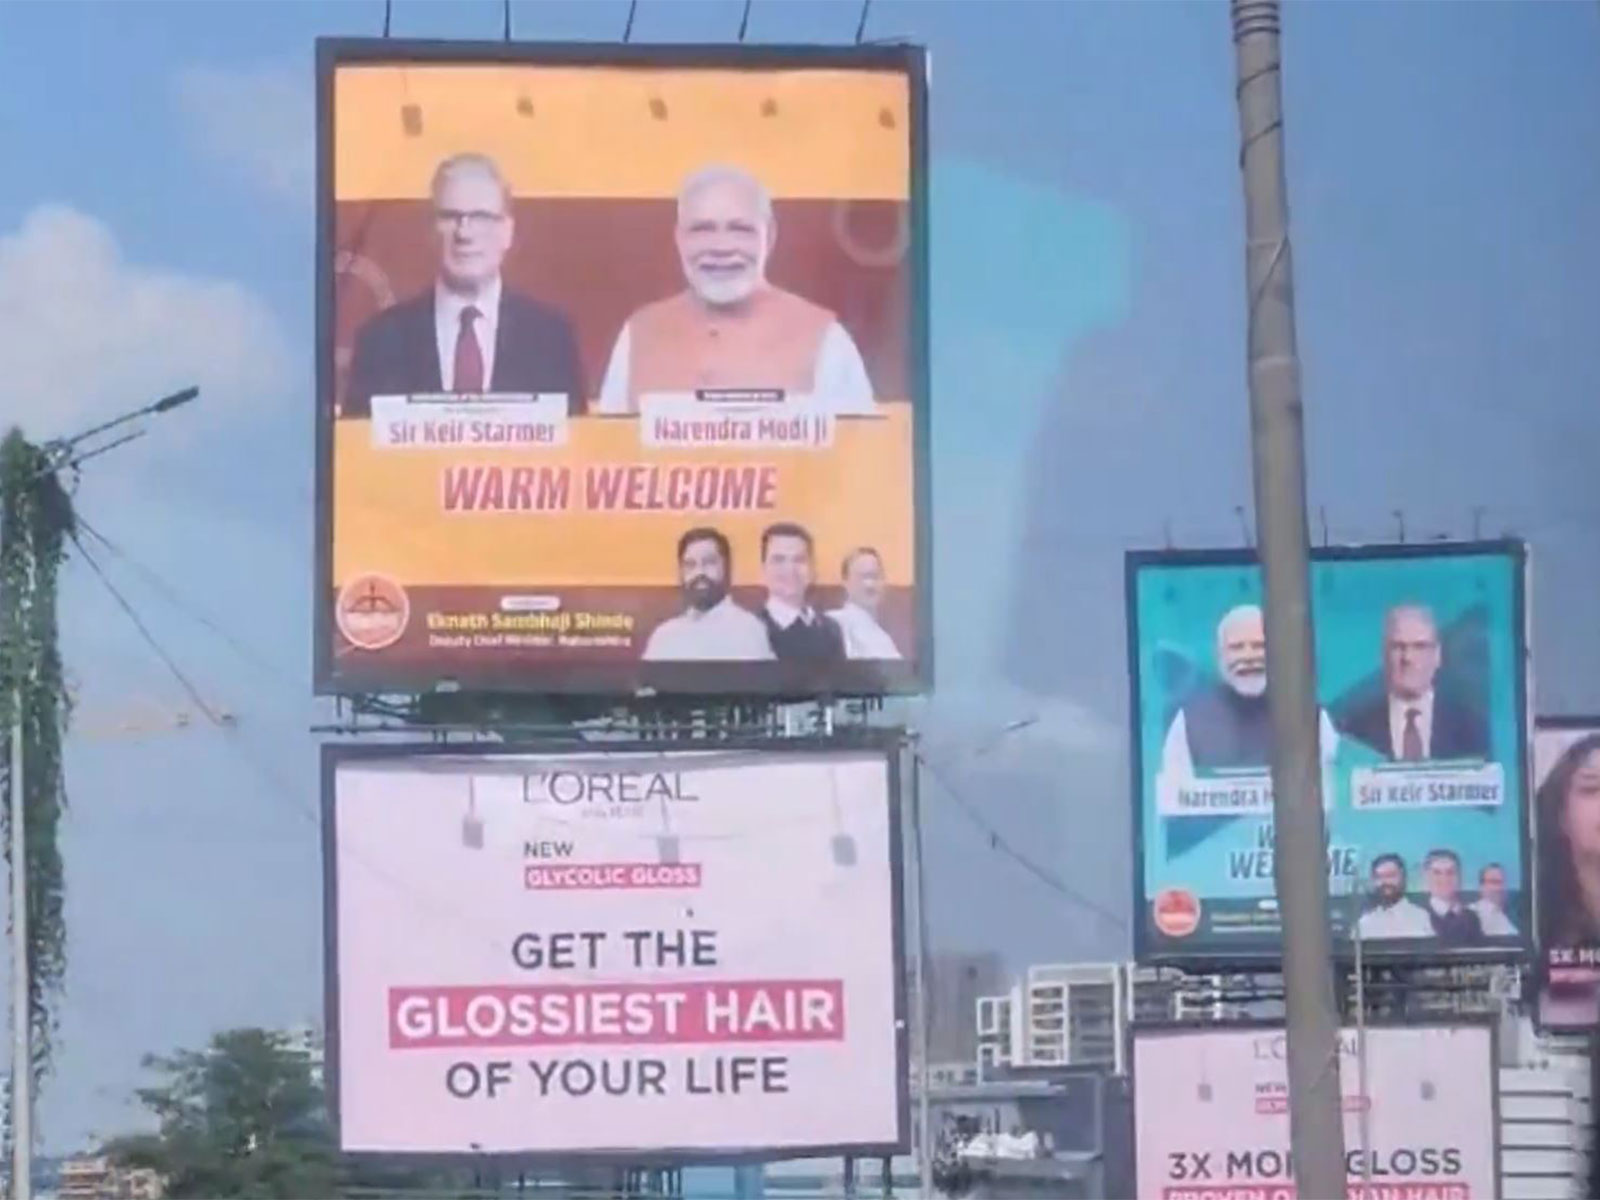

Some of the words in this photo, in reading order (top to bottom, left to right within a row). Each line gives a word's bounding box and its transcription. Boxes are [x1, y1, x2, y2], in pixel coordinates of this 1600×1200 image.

[389, 421, 416, 443] Sir
[471, 419, 555, 442] Starmer
[654, 416, 751, 441] Narendra
[757, 416, 808, 438] Modi
[444, 466, 570, 510] WARM
[586, 466, 777, 509] WELCOME
[524, 841, 574, 858] NEW
[527, 866, 626, 886] GLYCOLIC
[630, 865, 698, 884] GLOSS
[511, 932, 606, 970] GET
[623, 929, 717, 967] THE
[397, 993, 687, 1039] GLOSSIEST
[706, 988, 835, 1034] HAIR
[445, 1060, 512, 1099] OF
[528, 1058, 667, 1097] YOUR
[686, 1056, 789, 1094] LIFE
[1168, 1152, 1211, 1179] 3X
[1346, 1148, 1461, 1176] GLOSS
